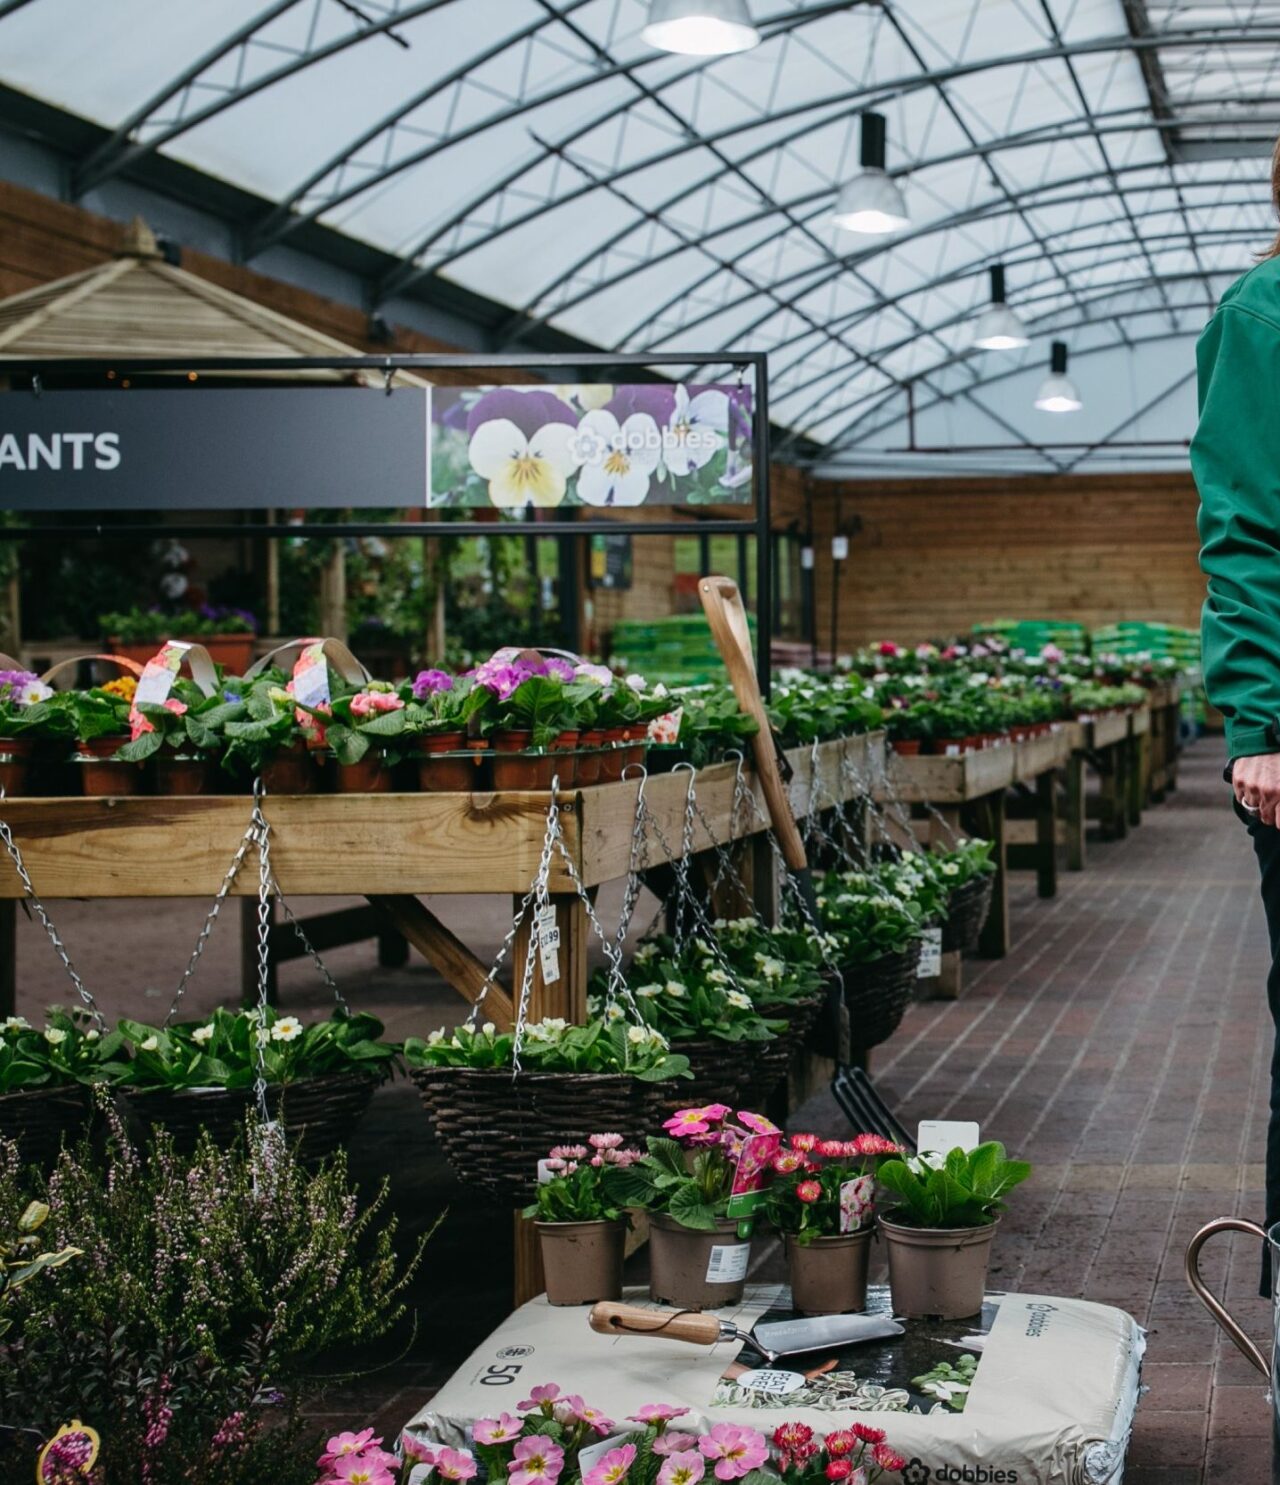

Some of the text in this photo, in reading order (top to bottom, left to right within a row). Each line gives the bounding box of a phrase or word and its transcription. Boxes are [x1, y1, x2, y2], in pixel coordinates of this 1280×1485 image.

[610, 425, 717, 449] dobbies
[0, 432, 121, 470] ANTS
[480, 1365, 523, 1386] 50
[773, 1371, 792, 1392] PEAT
[935, 1464, 1018, 1483] dobbies
